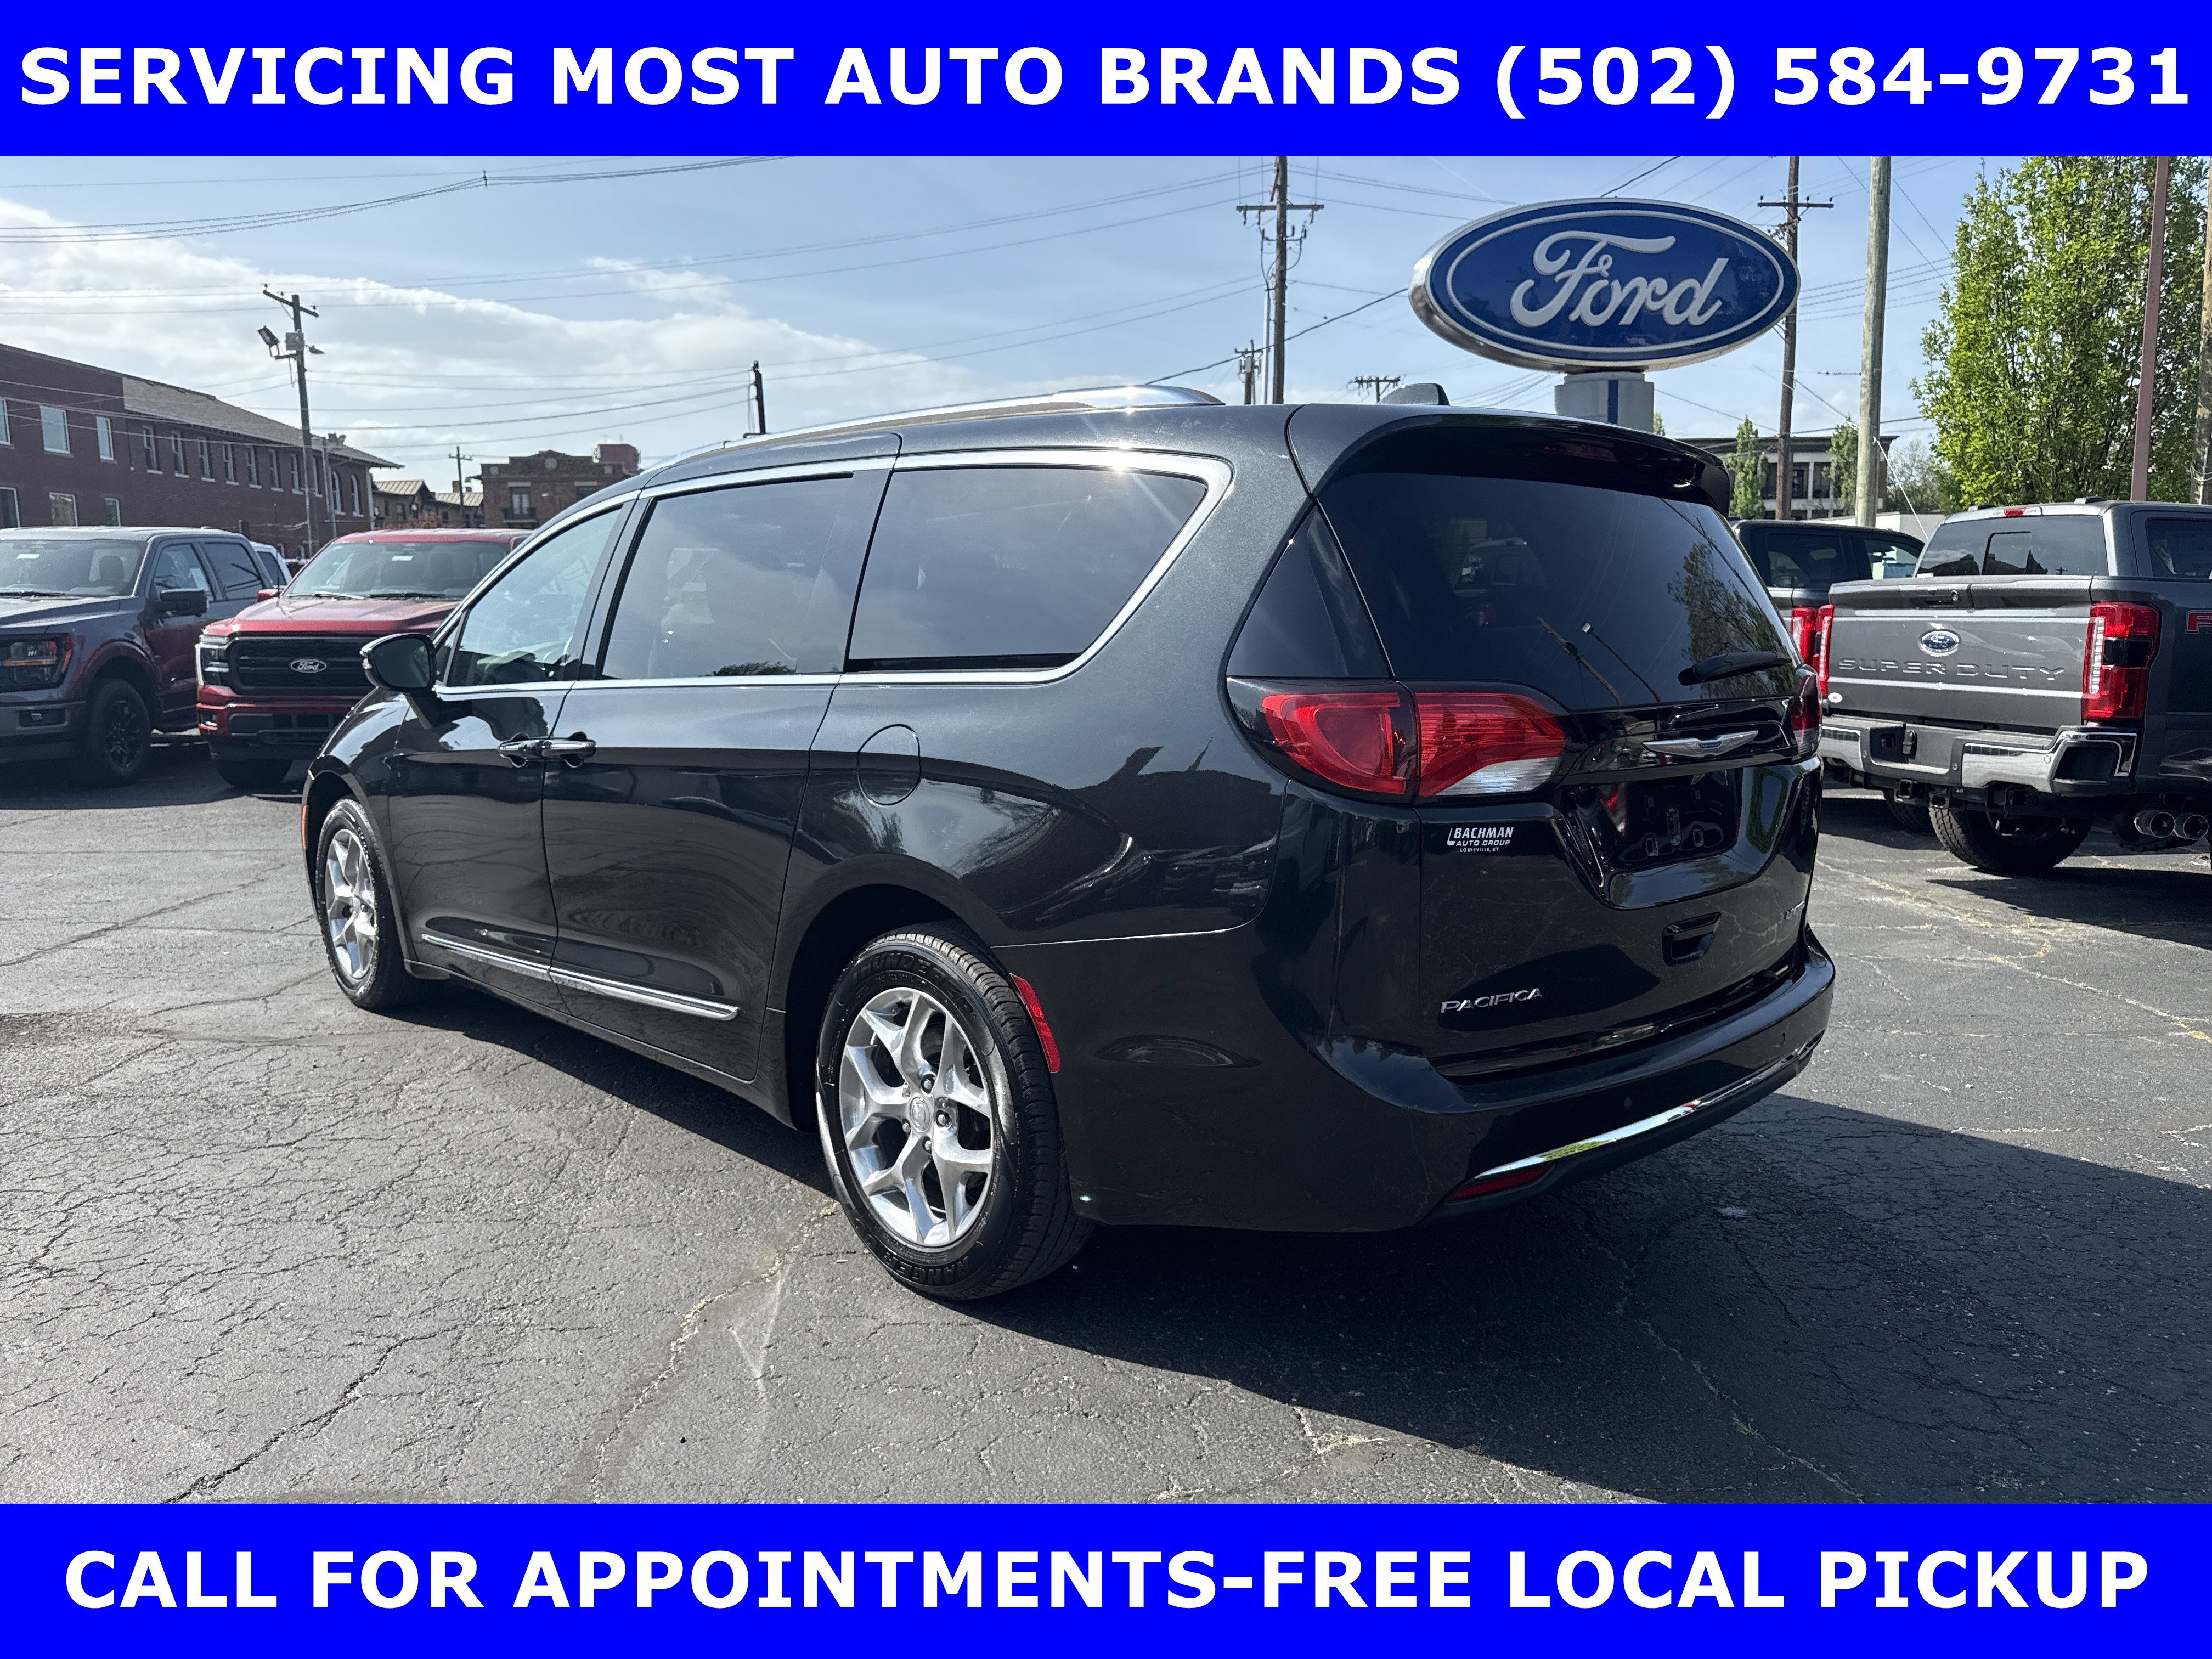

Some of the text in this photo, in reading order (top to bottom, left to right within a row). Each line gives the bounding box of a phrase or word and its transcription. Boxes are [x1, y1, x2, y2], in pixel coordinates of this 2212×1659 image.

[1510, 230, 1729, 327] Ford
[297, 660, 320, 670] Ford
[1839, 659, 2064, 681] SUPER DUTY
[1453, 827, 1514, 839] BACHMAN
[852, 952, 975, 1014] THUNDERER
[1440, 988, 1543, 1013] PACIFICA
